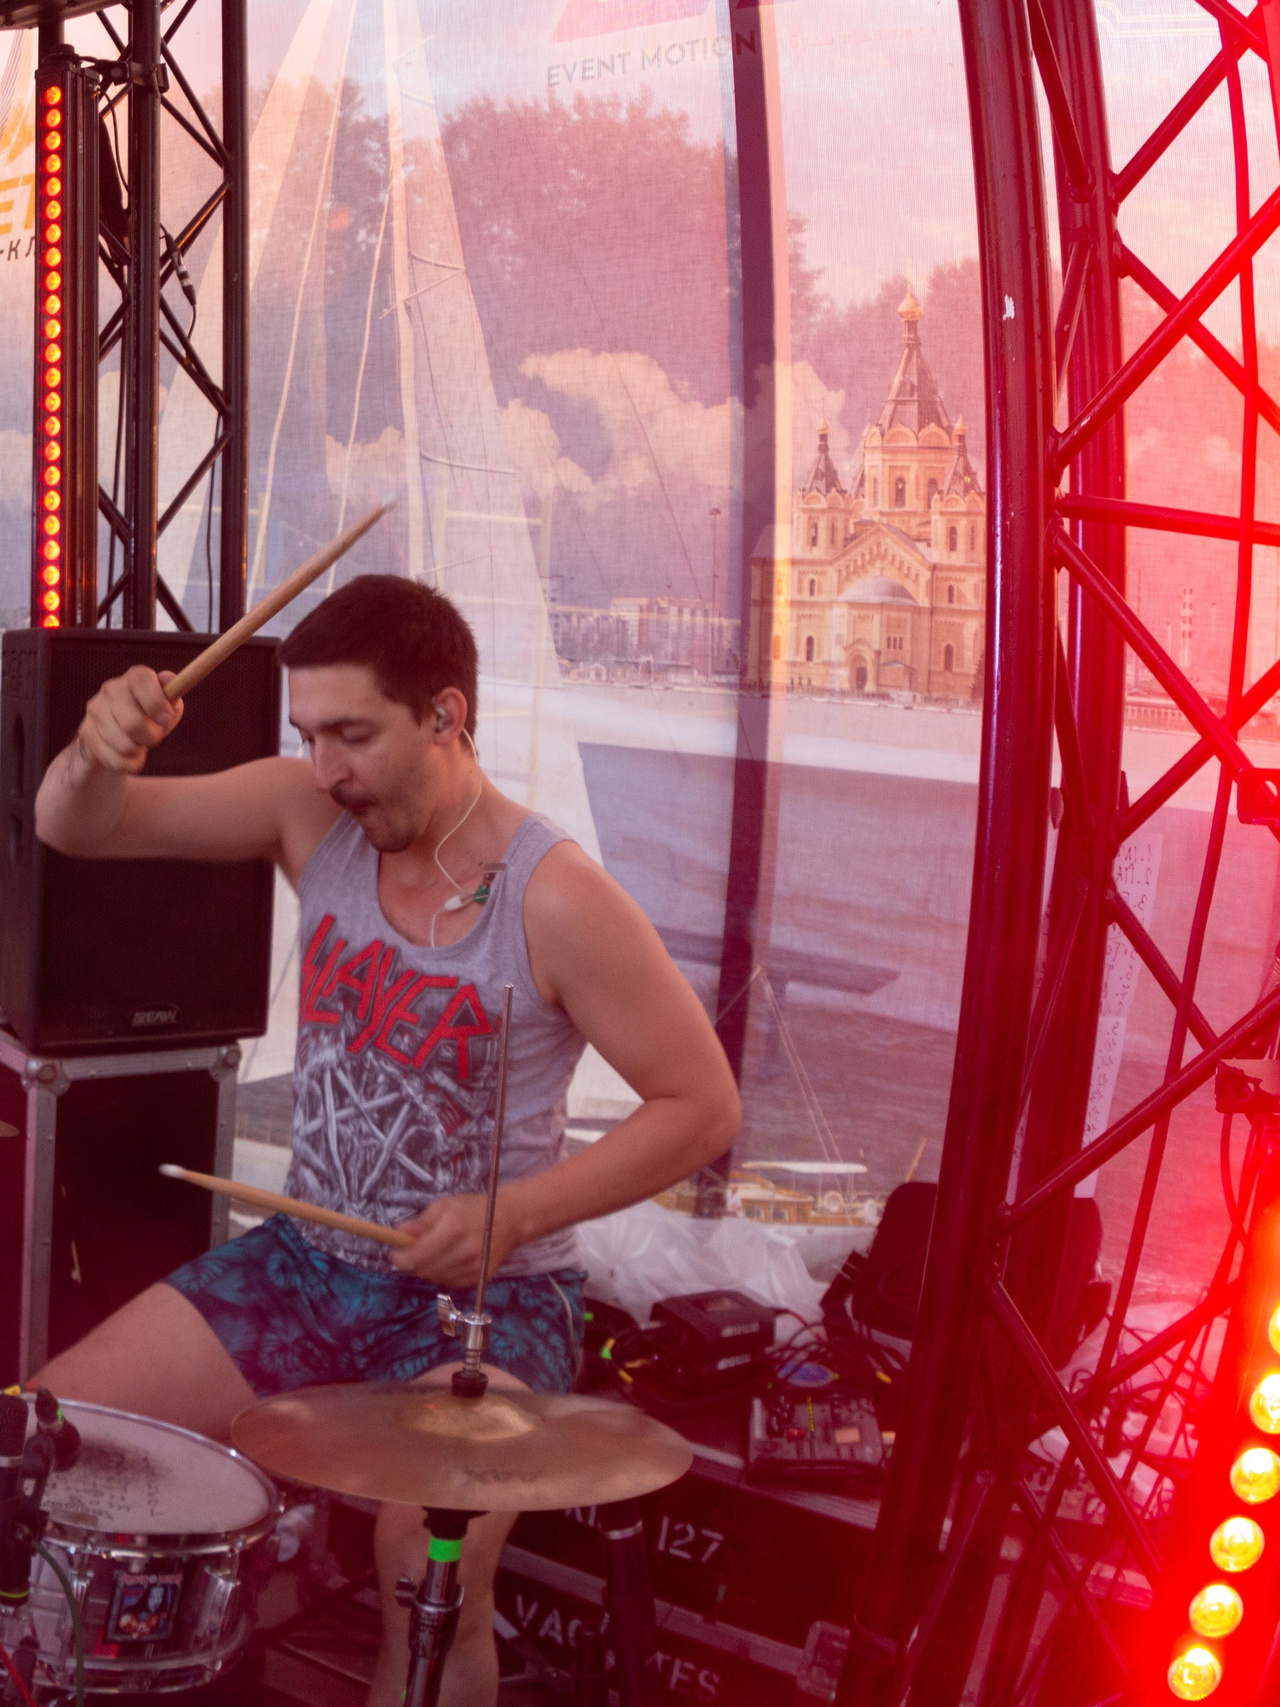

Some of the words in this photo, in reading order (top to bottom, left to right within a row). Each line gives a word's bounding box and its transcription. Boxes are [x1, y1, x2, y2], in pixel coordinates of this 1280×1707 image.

[545, 52, 632, 88] EVENT
[640, 30, 758, 71] MOTION
[299, 913, 494, 1081] SLAYER
[657, 1515, 724, 1564] 127
